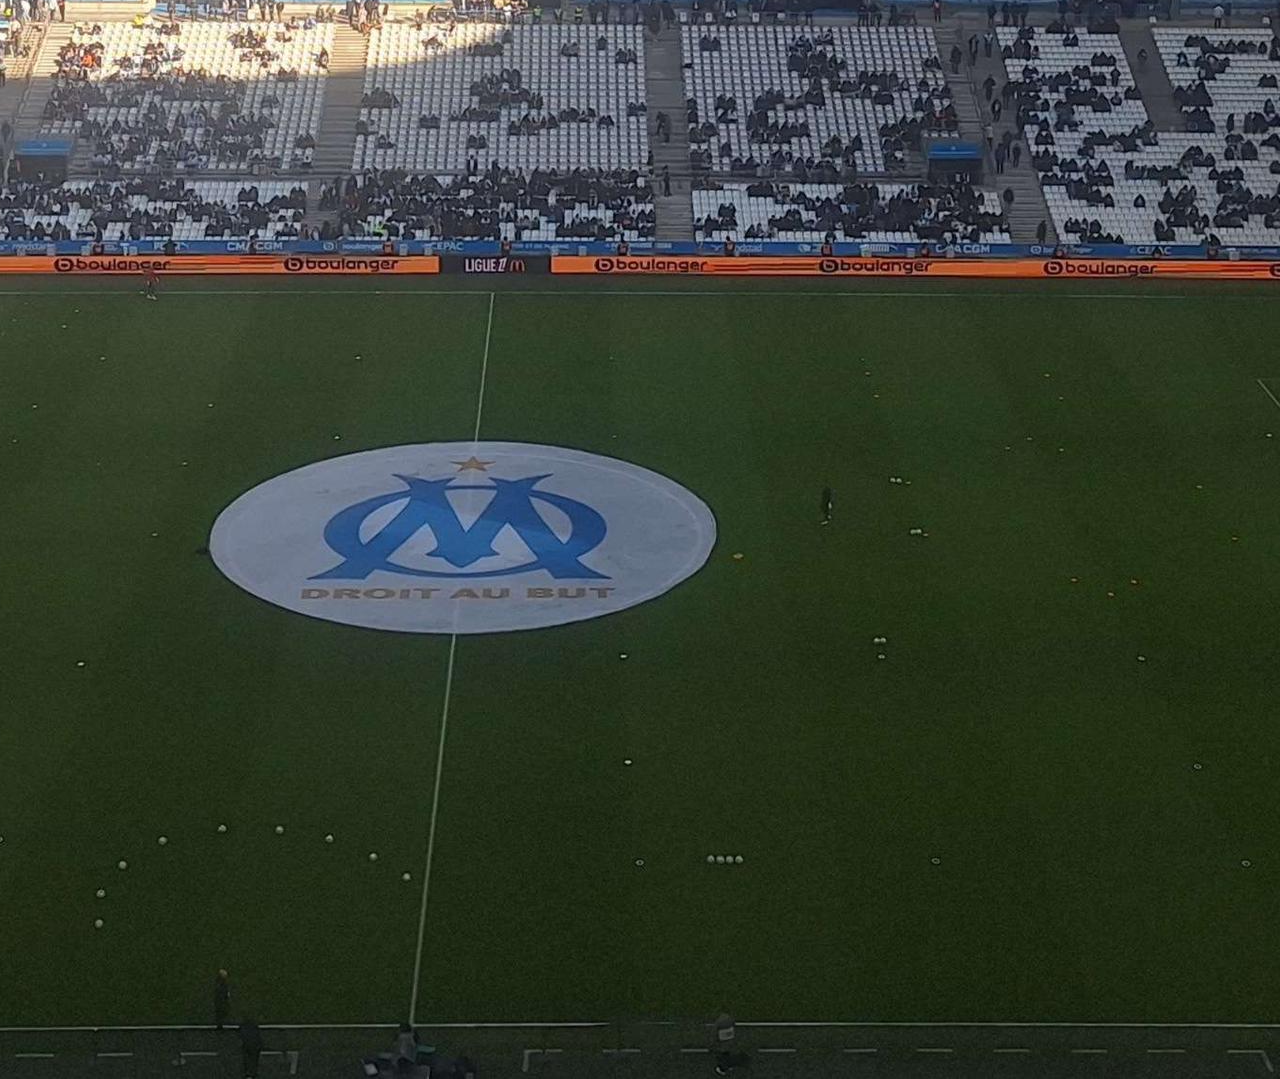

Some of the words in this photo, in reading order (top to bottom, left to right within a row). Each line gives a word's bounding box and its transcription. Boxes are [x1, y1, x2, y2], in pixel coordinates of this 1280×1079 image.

[255, 242, 283, 251] CGM
[430, 242, 464, 251] CEPAC
[963, 244, 990, 253] CGM
[306, 258, 399, 271] boulanger
[465, 258, 498, 273] LIGUE
[616, 258, 707, 272] boulanger
[840, 260, 932, 273] boulanger
[1065, 261, 1156, 275] boulanger
[300, 586, 441, 600] DROIT
[449, 586, 509, 600] AU
[526, 586, 616, 600] BUT
